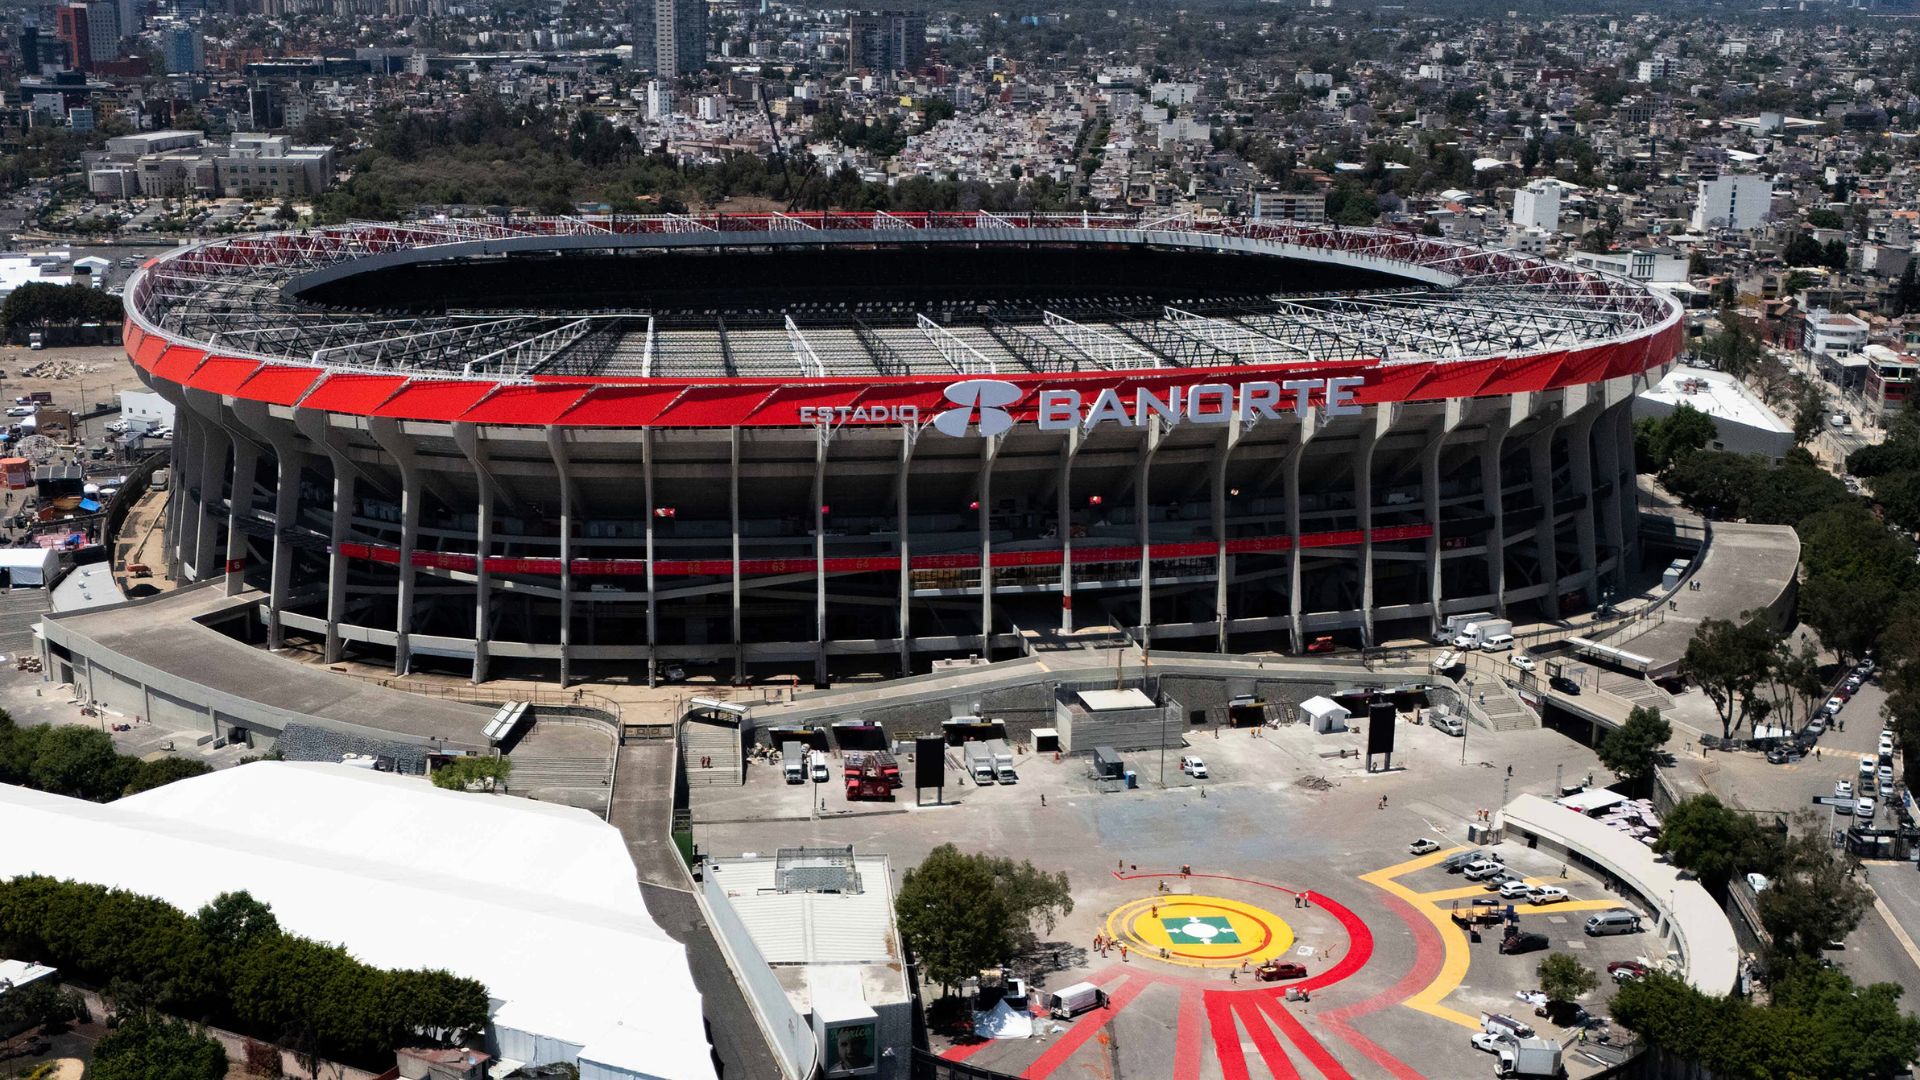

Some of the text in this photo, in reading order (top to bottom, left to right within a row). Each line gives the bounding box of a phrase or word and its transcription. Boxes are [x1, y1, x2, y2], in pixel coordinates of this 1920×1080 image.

[800, 376, 1365, 430] ESTADIO BANORTE
[772, 560, 785, 572] 63
[856, 559, 869, 570] 64
